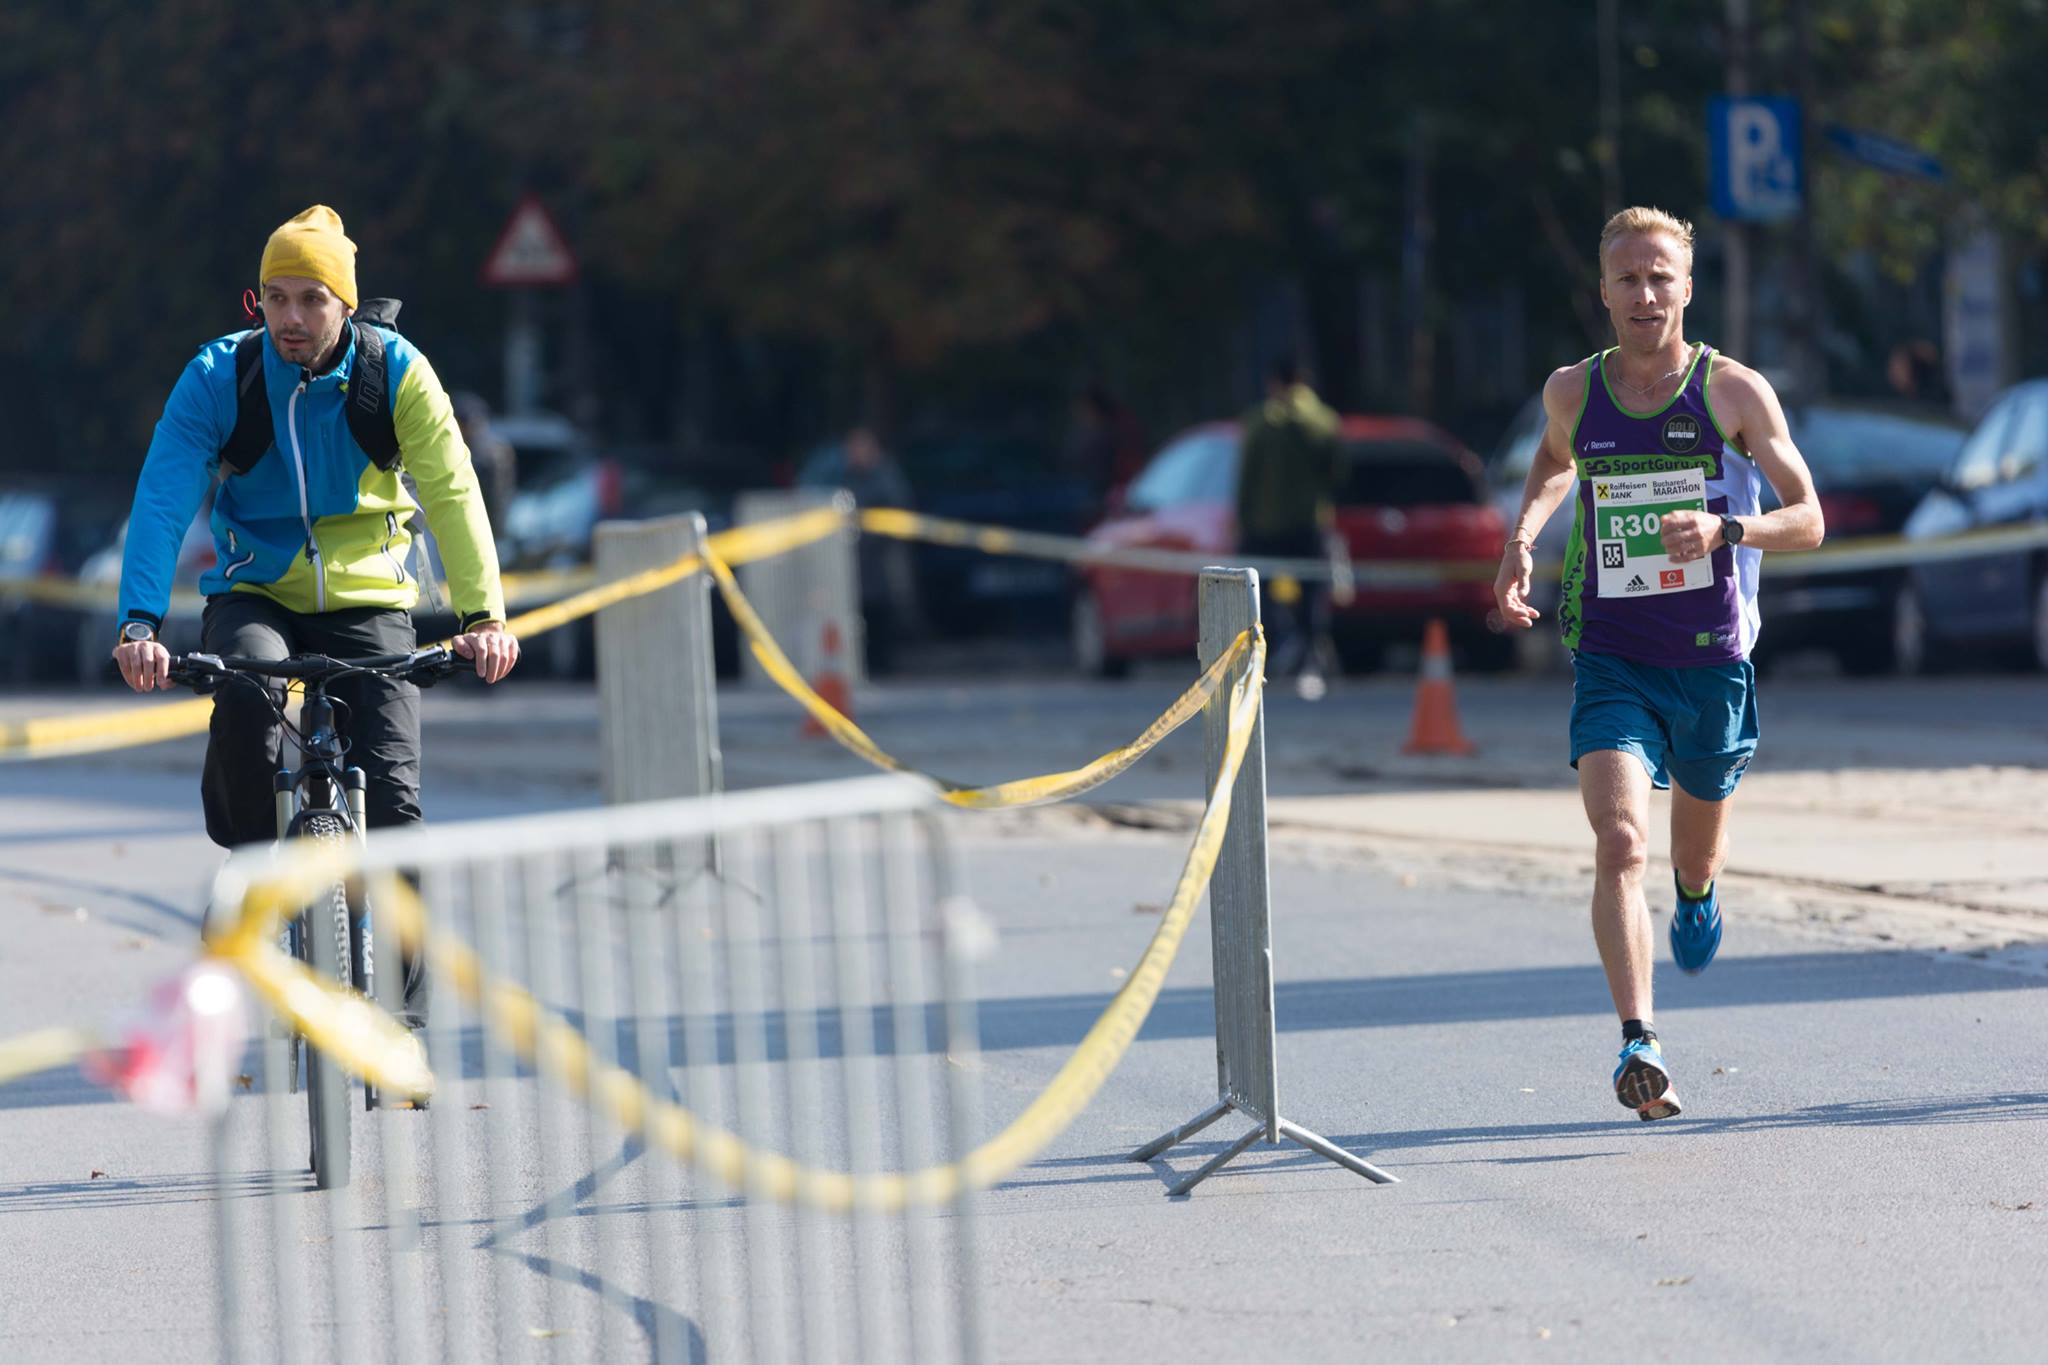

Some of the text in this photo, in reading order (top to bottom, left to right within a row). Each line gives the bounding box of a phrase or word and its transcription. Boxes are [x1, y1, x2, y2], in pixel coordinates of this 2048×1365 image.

[1727, 102, 1781, 208] P
[1668, 422, 1696, 432] GOLD
[1667, 431, 1696, 439] NUTRITION
[1590, 441, 1616, 450] Rexona
[1613, 458, 1709, 474] SportGuru.ro
[1609, 482, 1647, 491] Raiffeisen
[1652, 478, 1687, 488] Bucharest
[1610, 491, 1632, 499] BANK
[1653, 484, 1700, 496] MARATHON
[1610, 512, 1660, 538] R30
[1624, 585, 1650, 593] adidas
